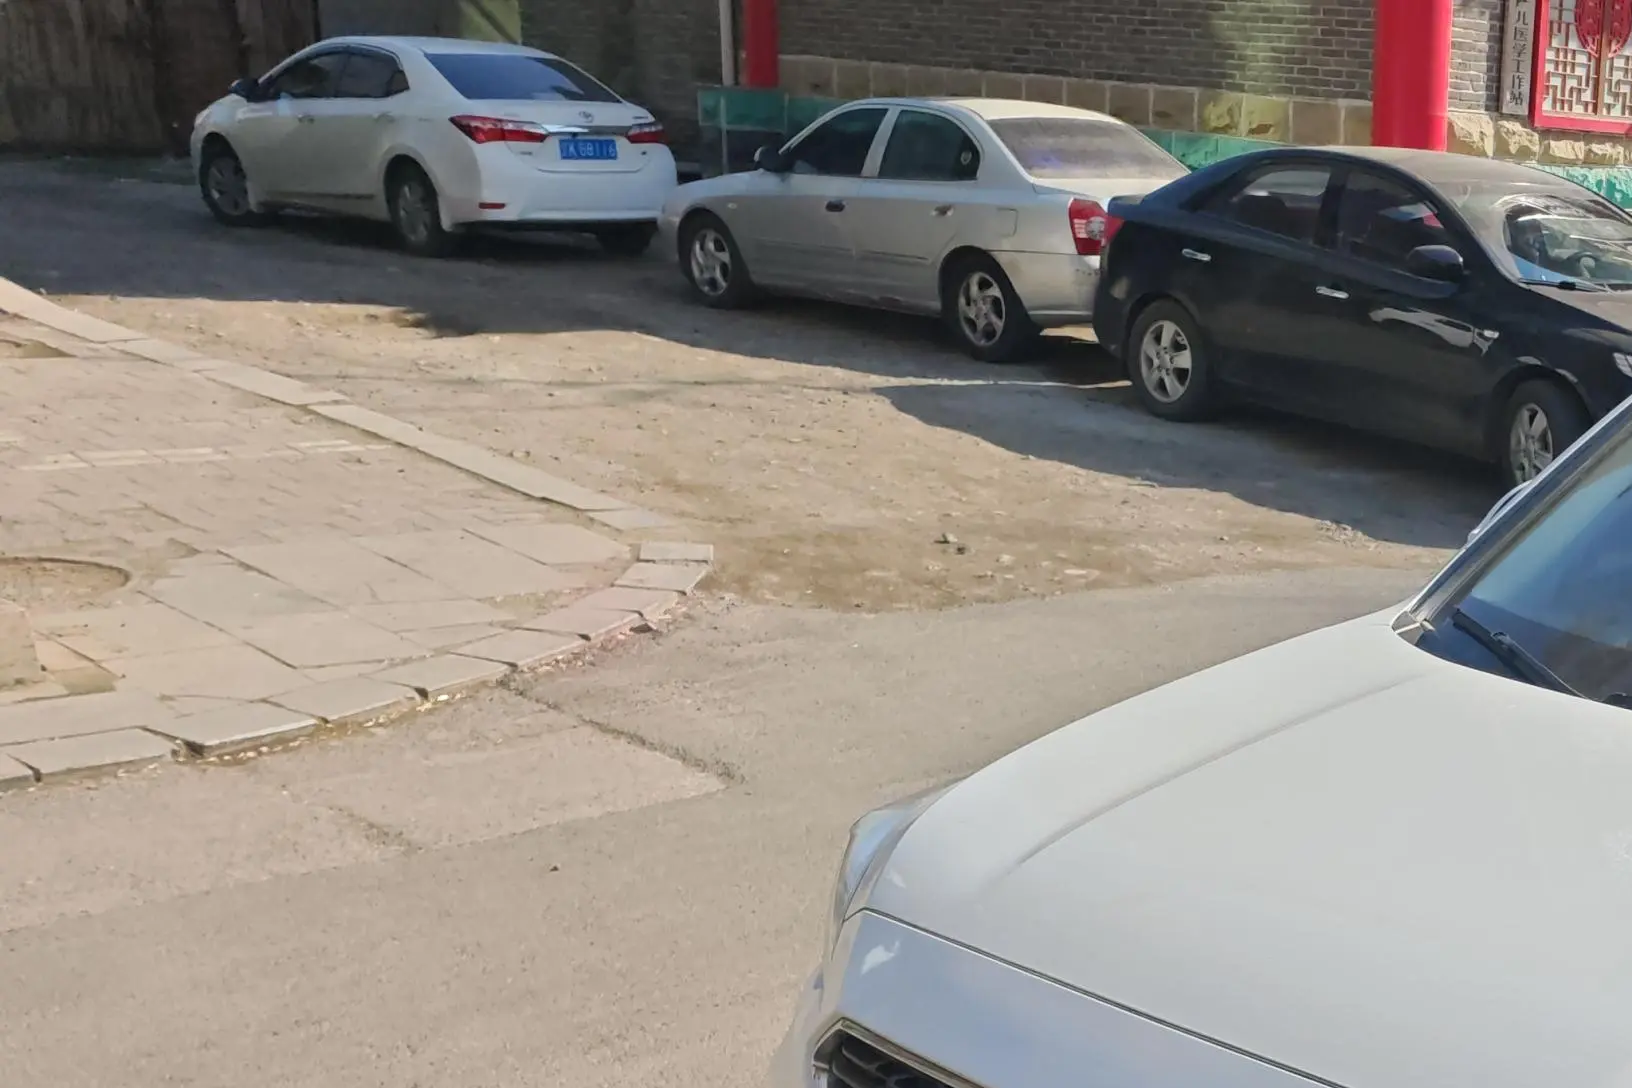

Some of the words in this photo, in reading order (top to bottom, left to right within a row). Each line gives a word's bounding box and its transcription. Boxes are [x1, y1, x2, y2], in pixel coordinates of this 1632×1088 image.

[1510, 0, 1530, 106] 儿医学工作站
